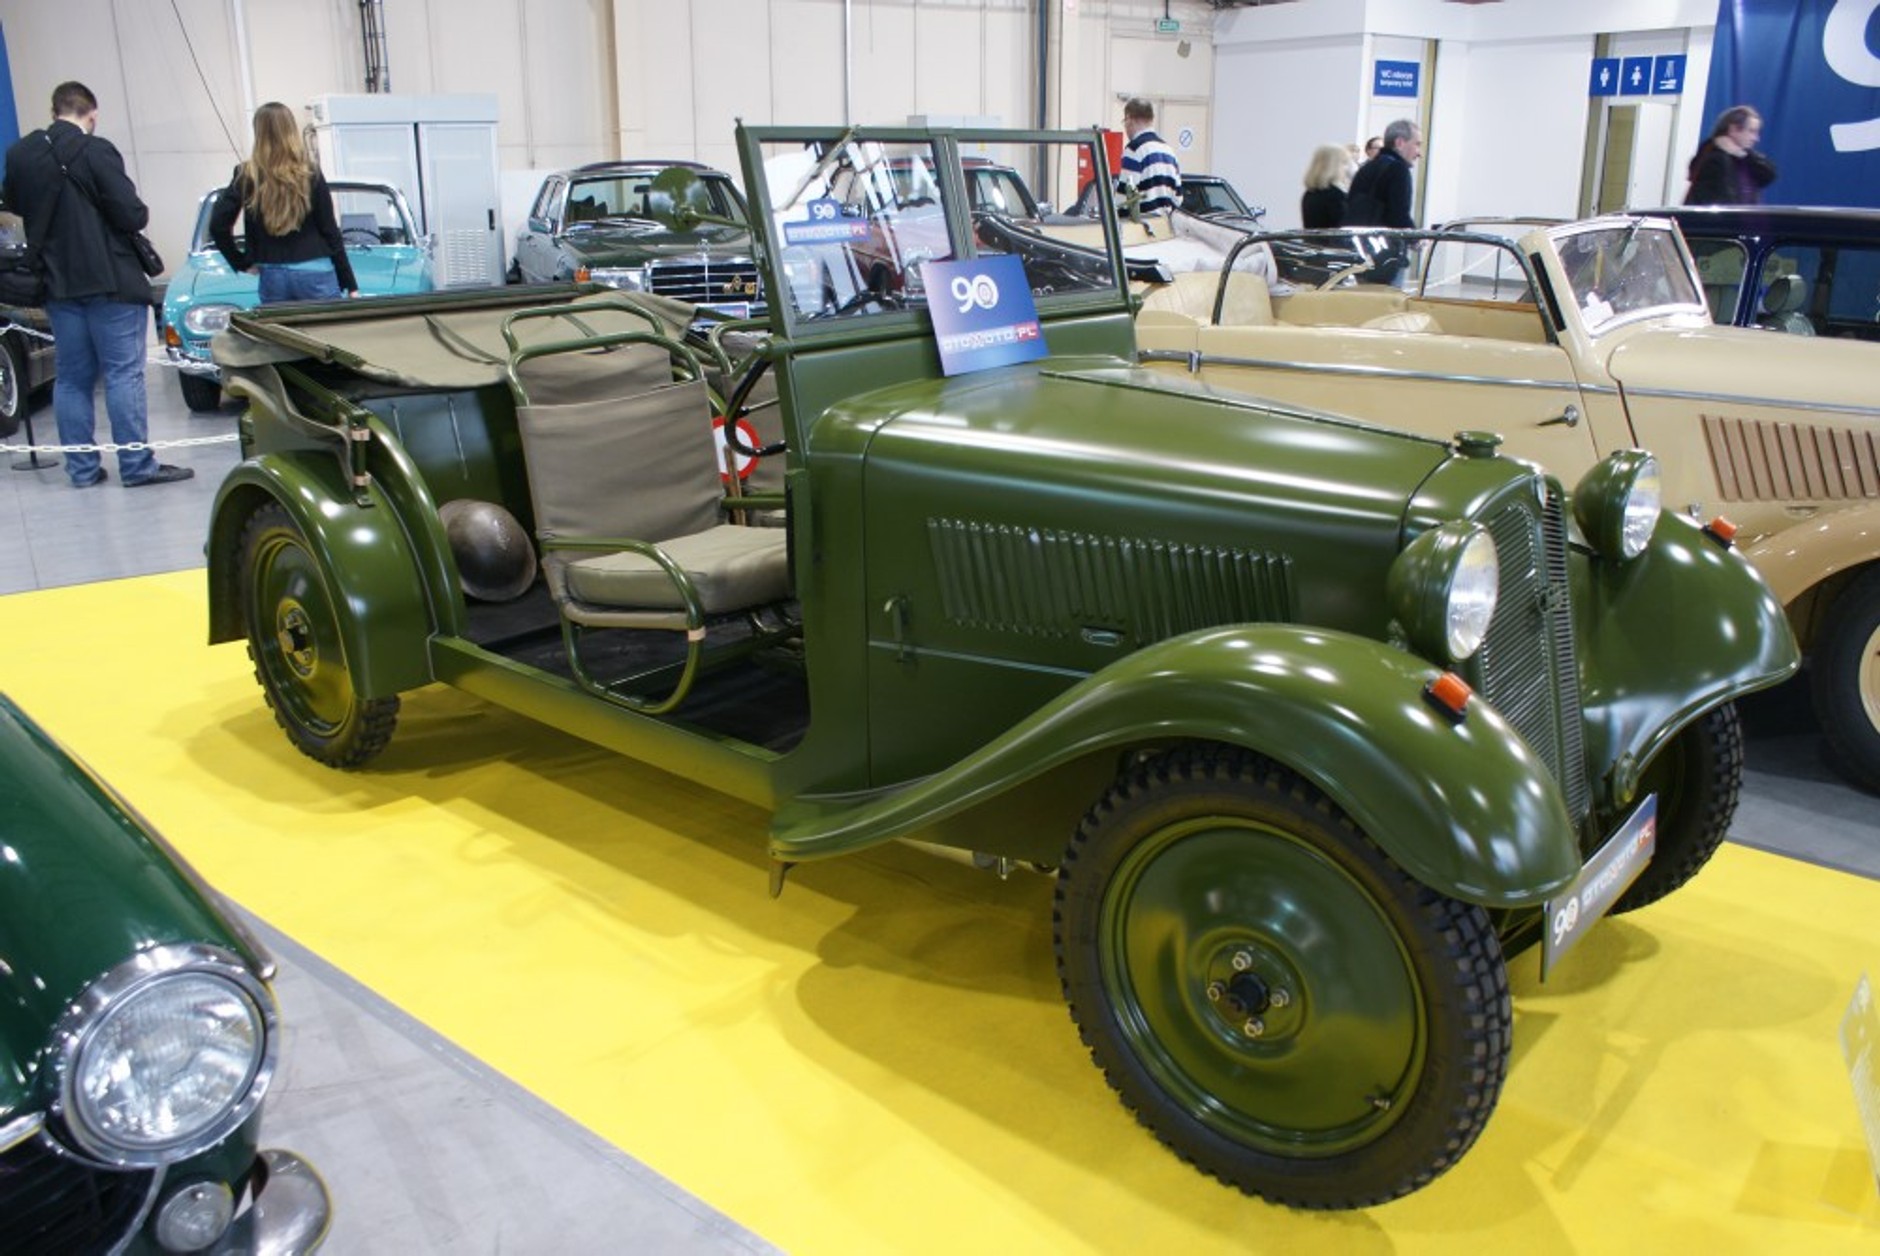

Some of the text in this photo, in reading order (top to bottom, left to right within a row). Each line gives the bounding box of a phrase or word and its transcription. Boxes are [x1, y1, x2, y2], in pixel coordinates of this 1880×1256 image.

[813, 203, 836, 220] 90
[951, 274, 999, 313] 90
[1554, 896, 1579, 946] 90
